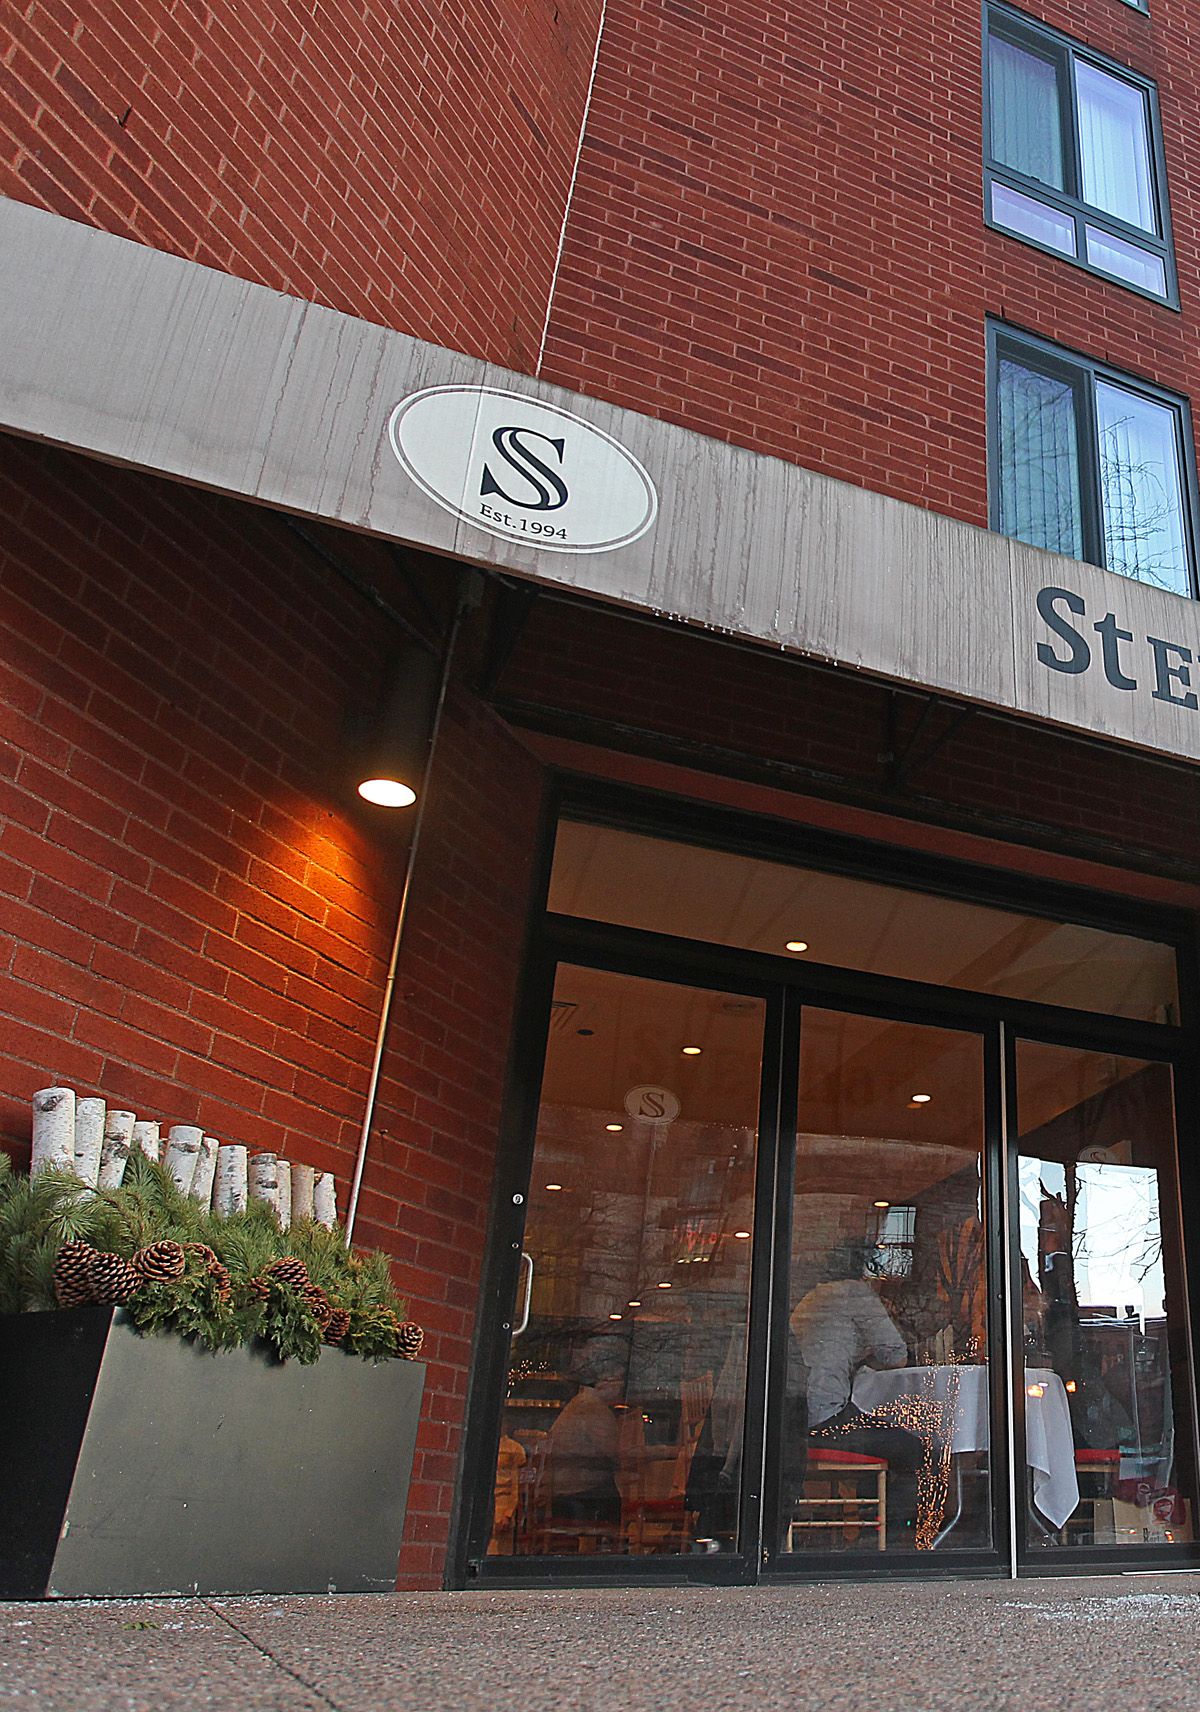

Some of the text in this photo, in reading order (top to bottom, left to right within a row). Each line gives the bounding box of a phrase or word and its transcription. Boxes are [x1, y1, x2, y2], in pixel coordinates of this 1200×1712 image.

[480, 426, 568, 511] S
[479, 502, 568, 540] Est.1994
[638, 1091, 666, 1118] S
